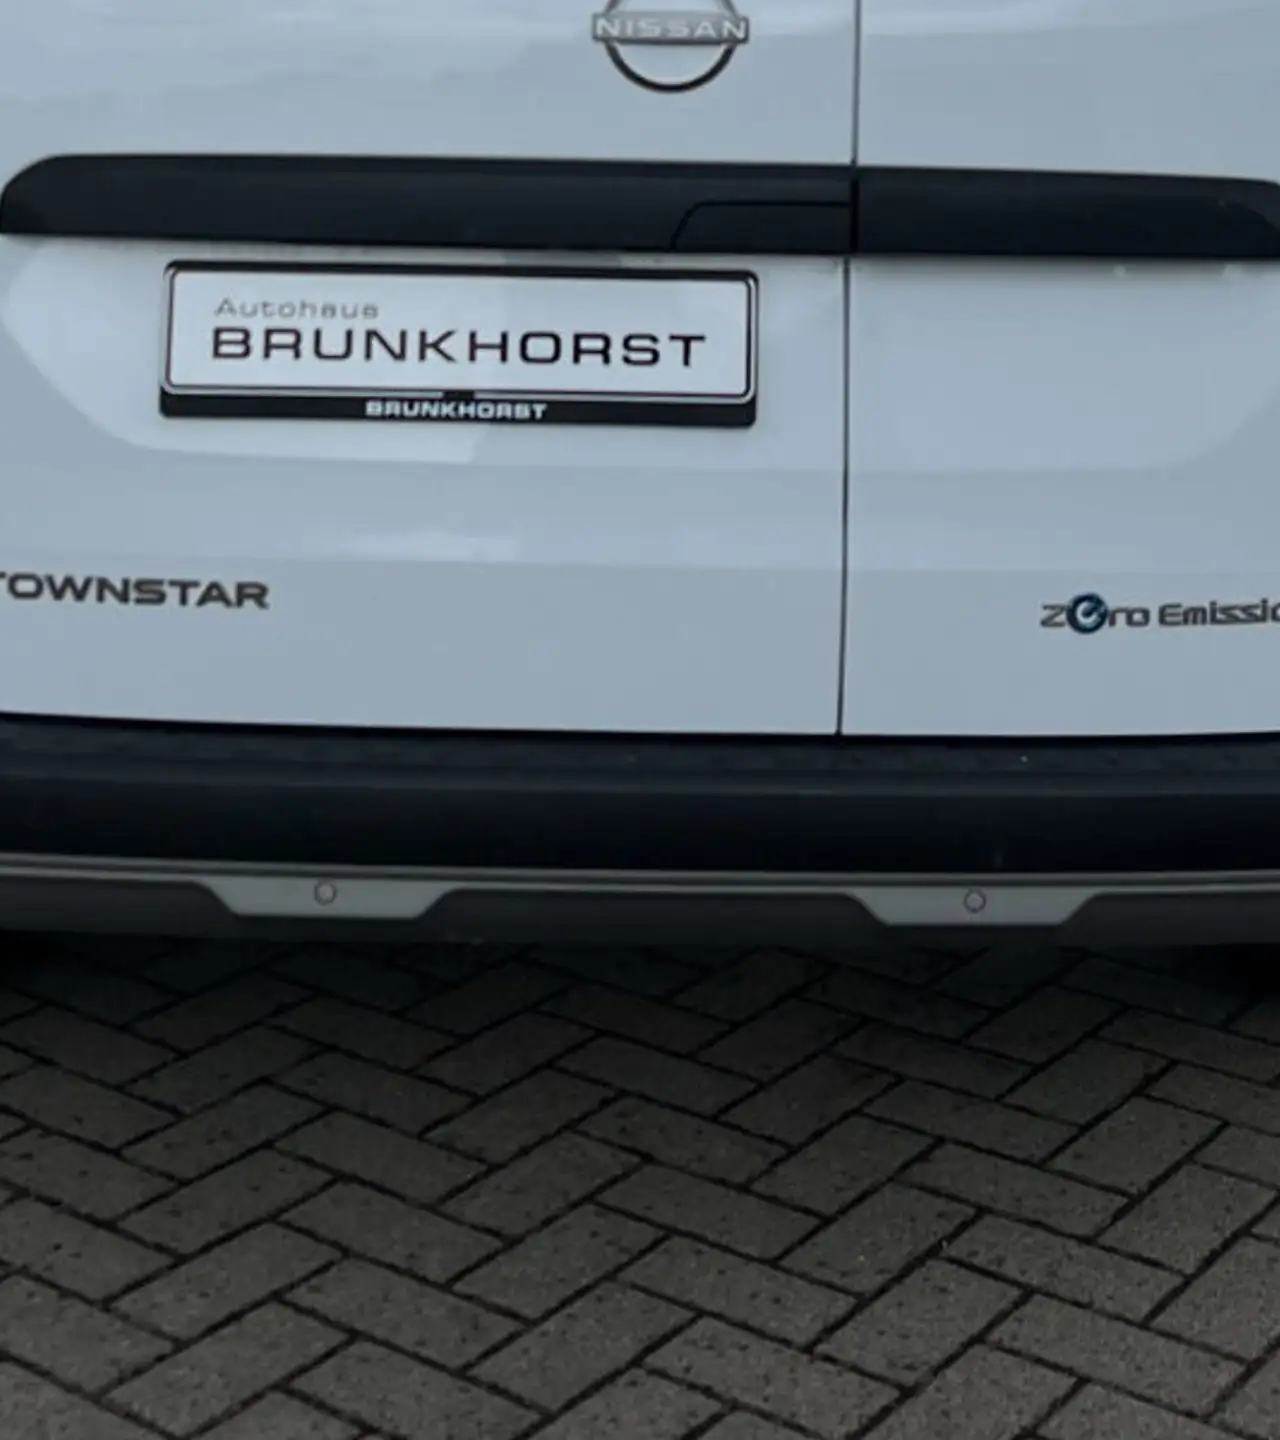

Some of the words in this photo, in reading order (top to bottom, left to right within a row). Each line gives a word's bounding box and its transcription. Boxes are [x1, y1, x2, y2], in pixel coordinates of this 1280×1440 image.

[596, 17, 747, 40] NISSAN
[214, 297, 379, 319] Autohaus
[212, 326, 706, 367] BRUNKHORST
[365, 400, 547, 420] BRUNKHORST
